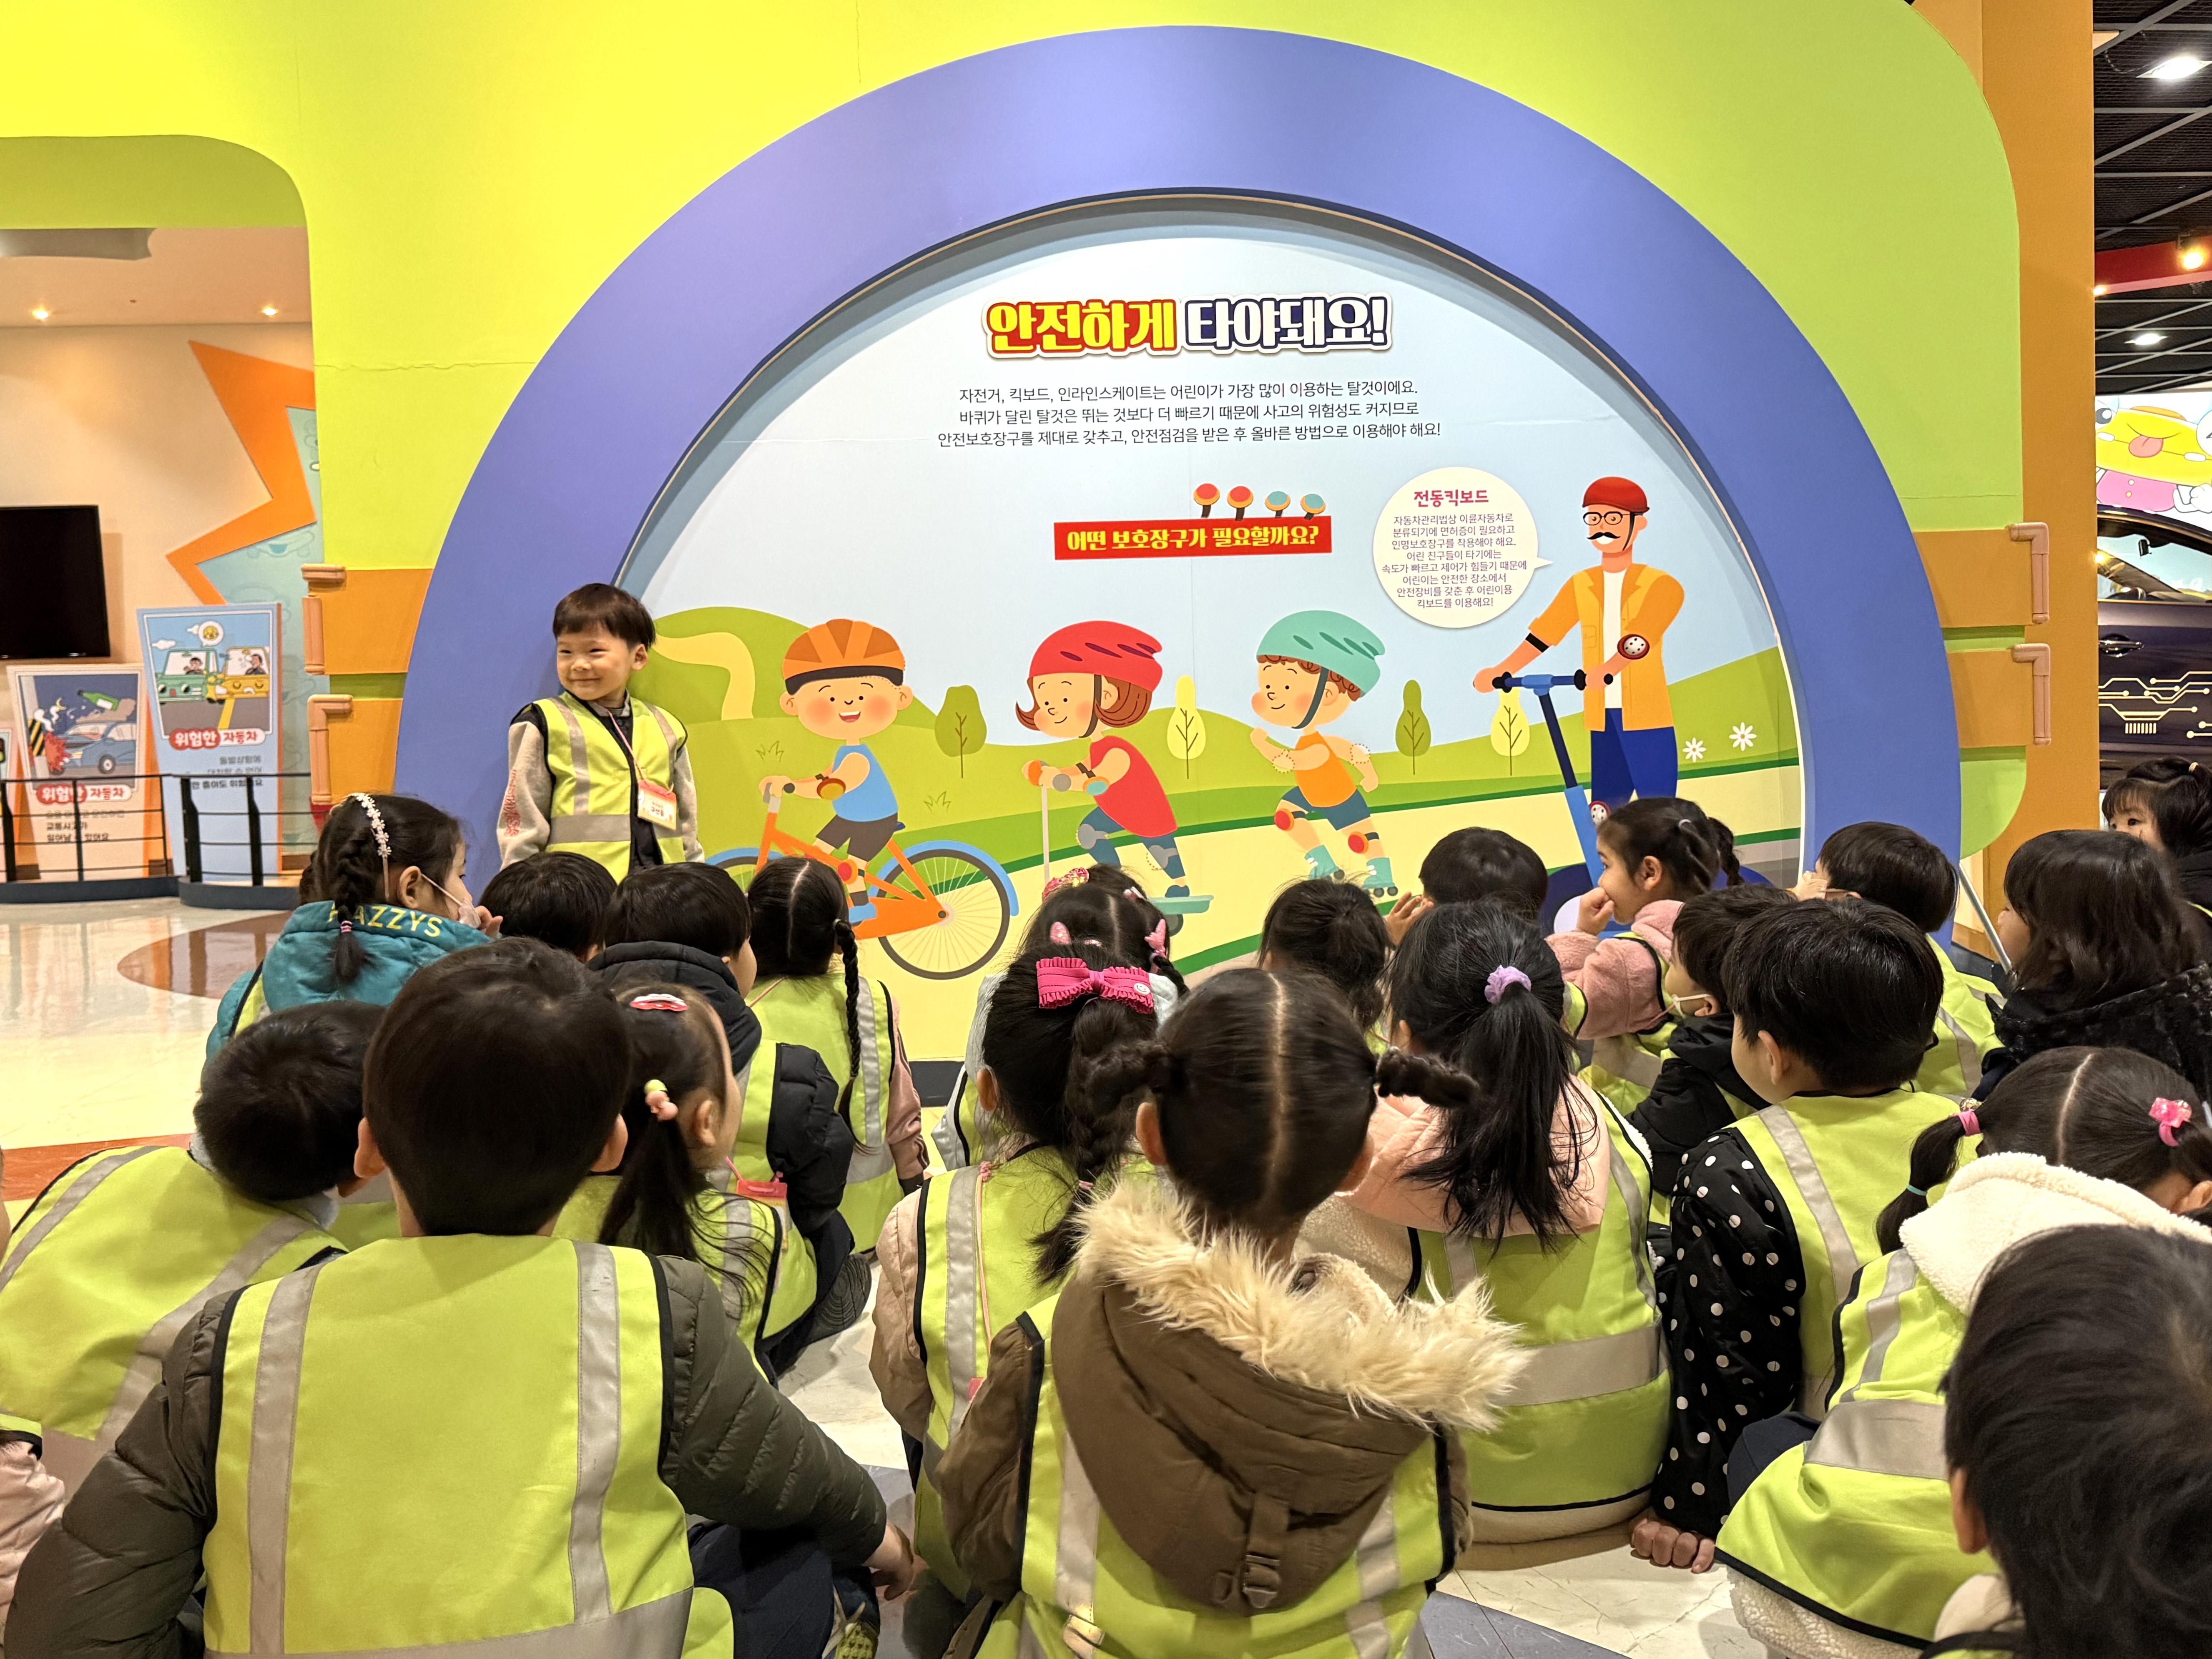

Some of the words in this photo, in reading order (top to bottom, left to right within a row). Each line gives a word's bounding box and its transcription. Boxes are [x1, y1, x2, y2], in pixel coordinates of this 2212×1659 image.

[988, 300, 1175, 353] 안전하게
[1186, 297, 1386, 348] 타야돼요!
[959, 388, 1004, 404] 자전거,
[1009, 388, 1053, 403] 킥보드,
[1058, 385, 1167, 402] 인라인스케이트는
[1170, 384, 1224, 399] 어린이가
[1228, 383, 1255, 399] 가장
[1259, 382, 1285, 398] 많이
[1290, 381, 1344, 397] 이용하는
[1347, 380, 1418, 396] 탈것이에요.
[959, 410, 1002, 426] 바퀴가
[1005, 409, 1032, 425] 달린
[1037, 409, 1078, 424] 탈것은
[1082, 408, 1109, 423] 뛰는
[1113, 407, 1154, 422] 것보다
[1158, 407, 1170, 422] 더
[1175, 406, 1214, 421] 빠르기
[1219, 405, 1259, 420] 때문에
[1263, 404, 1303, 419] 사고의
[1308, 403, 1362, 418] 위험성도
[1366, 402, 1419, 417] 커지므로
[938, 431, 1034, 447] 안전보호장구를
[1038, 431, 1080, 446] 제대로
[1083, 429, 1127, 445] 갖추고,
[1131, 428, 1199, 444] 안전점검을
[1202, 427, 1230, 442] 받은
[1233, 427, 1247, 442] 후
[1250, 426, 1291, 441] 올바른
[1295, 425, 1349, 440] 방법으로
[1353, 423, 1407, 439] 이용해야
[1410, 422, 1440, 437] 해요!
[1414, 490, 1488, 507] 전동킥보드
[1393, 514, 1457, 525] 자동차관리법상
[1459, 513, 1514, 524] 이륜자동차로
[1393, 527, 1437, 537] 분류되기에
[1441, 526, 1476, 537] 면허증이
[1479, 525, 1515, 535] 필요하고
[1067, 530, 1107, 551] 어떤
[1112, 528, 1208, 550] 보호장구가
[1212, 526, 1319, 547] 필요할까요?
[1391, 538, 1454, 550] 인명보호장구를
[1457, 537, 1493, 548] 착용해야
[1495, 537, 1517, 547] 해요.
[1406, 551, 1424, 561] 어린
[1427, 550, 1463, 561] 친구들이
[1466, 549, 1502, 560] 타기에는
[1381, 563, 1409, 574] 속도가
[1411, 563, 1439, 573] 빠르고
[1441, 562, 1468, 572] 제어가
[1471, 561, 1497, 572] 힘들기
[1500, 560, 1527, 570] 때문에
[1403, 575, 1439, 585] 어린이는
[1441, 574, 1468, 585] 안전한
[1470, 573, 1506, 584] 장소에서
[1396, 587, 1441, 597] 안전장비를
[1444, 586, 1463, 596] 갖춘
[1465, 586, 1474, 596] 후
[1476, 585, 1513, 595] 어린이용
[1417, 598, 1452, 609] 킥보드를
[1455, 597, 1493, 608] 이용해요!
[175, 731, 216, 747] 위험한
[223, 731, 257, 744] 자동차
[90, 787, 124, 800] 자동차
